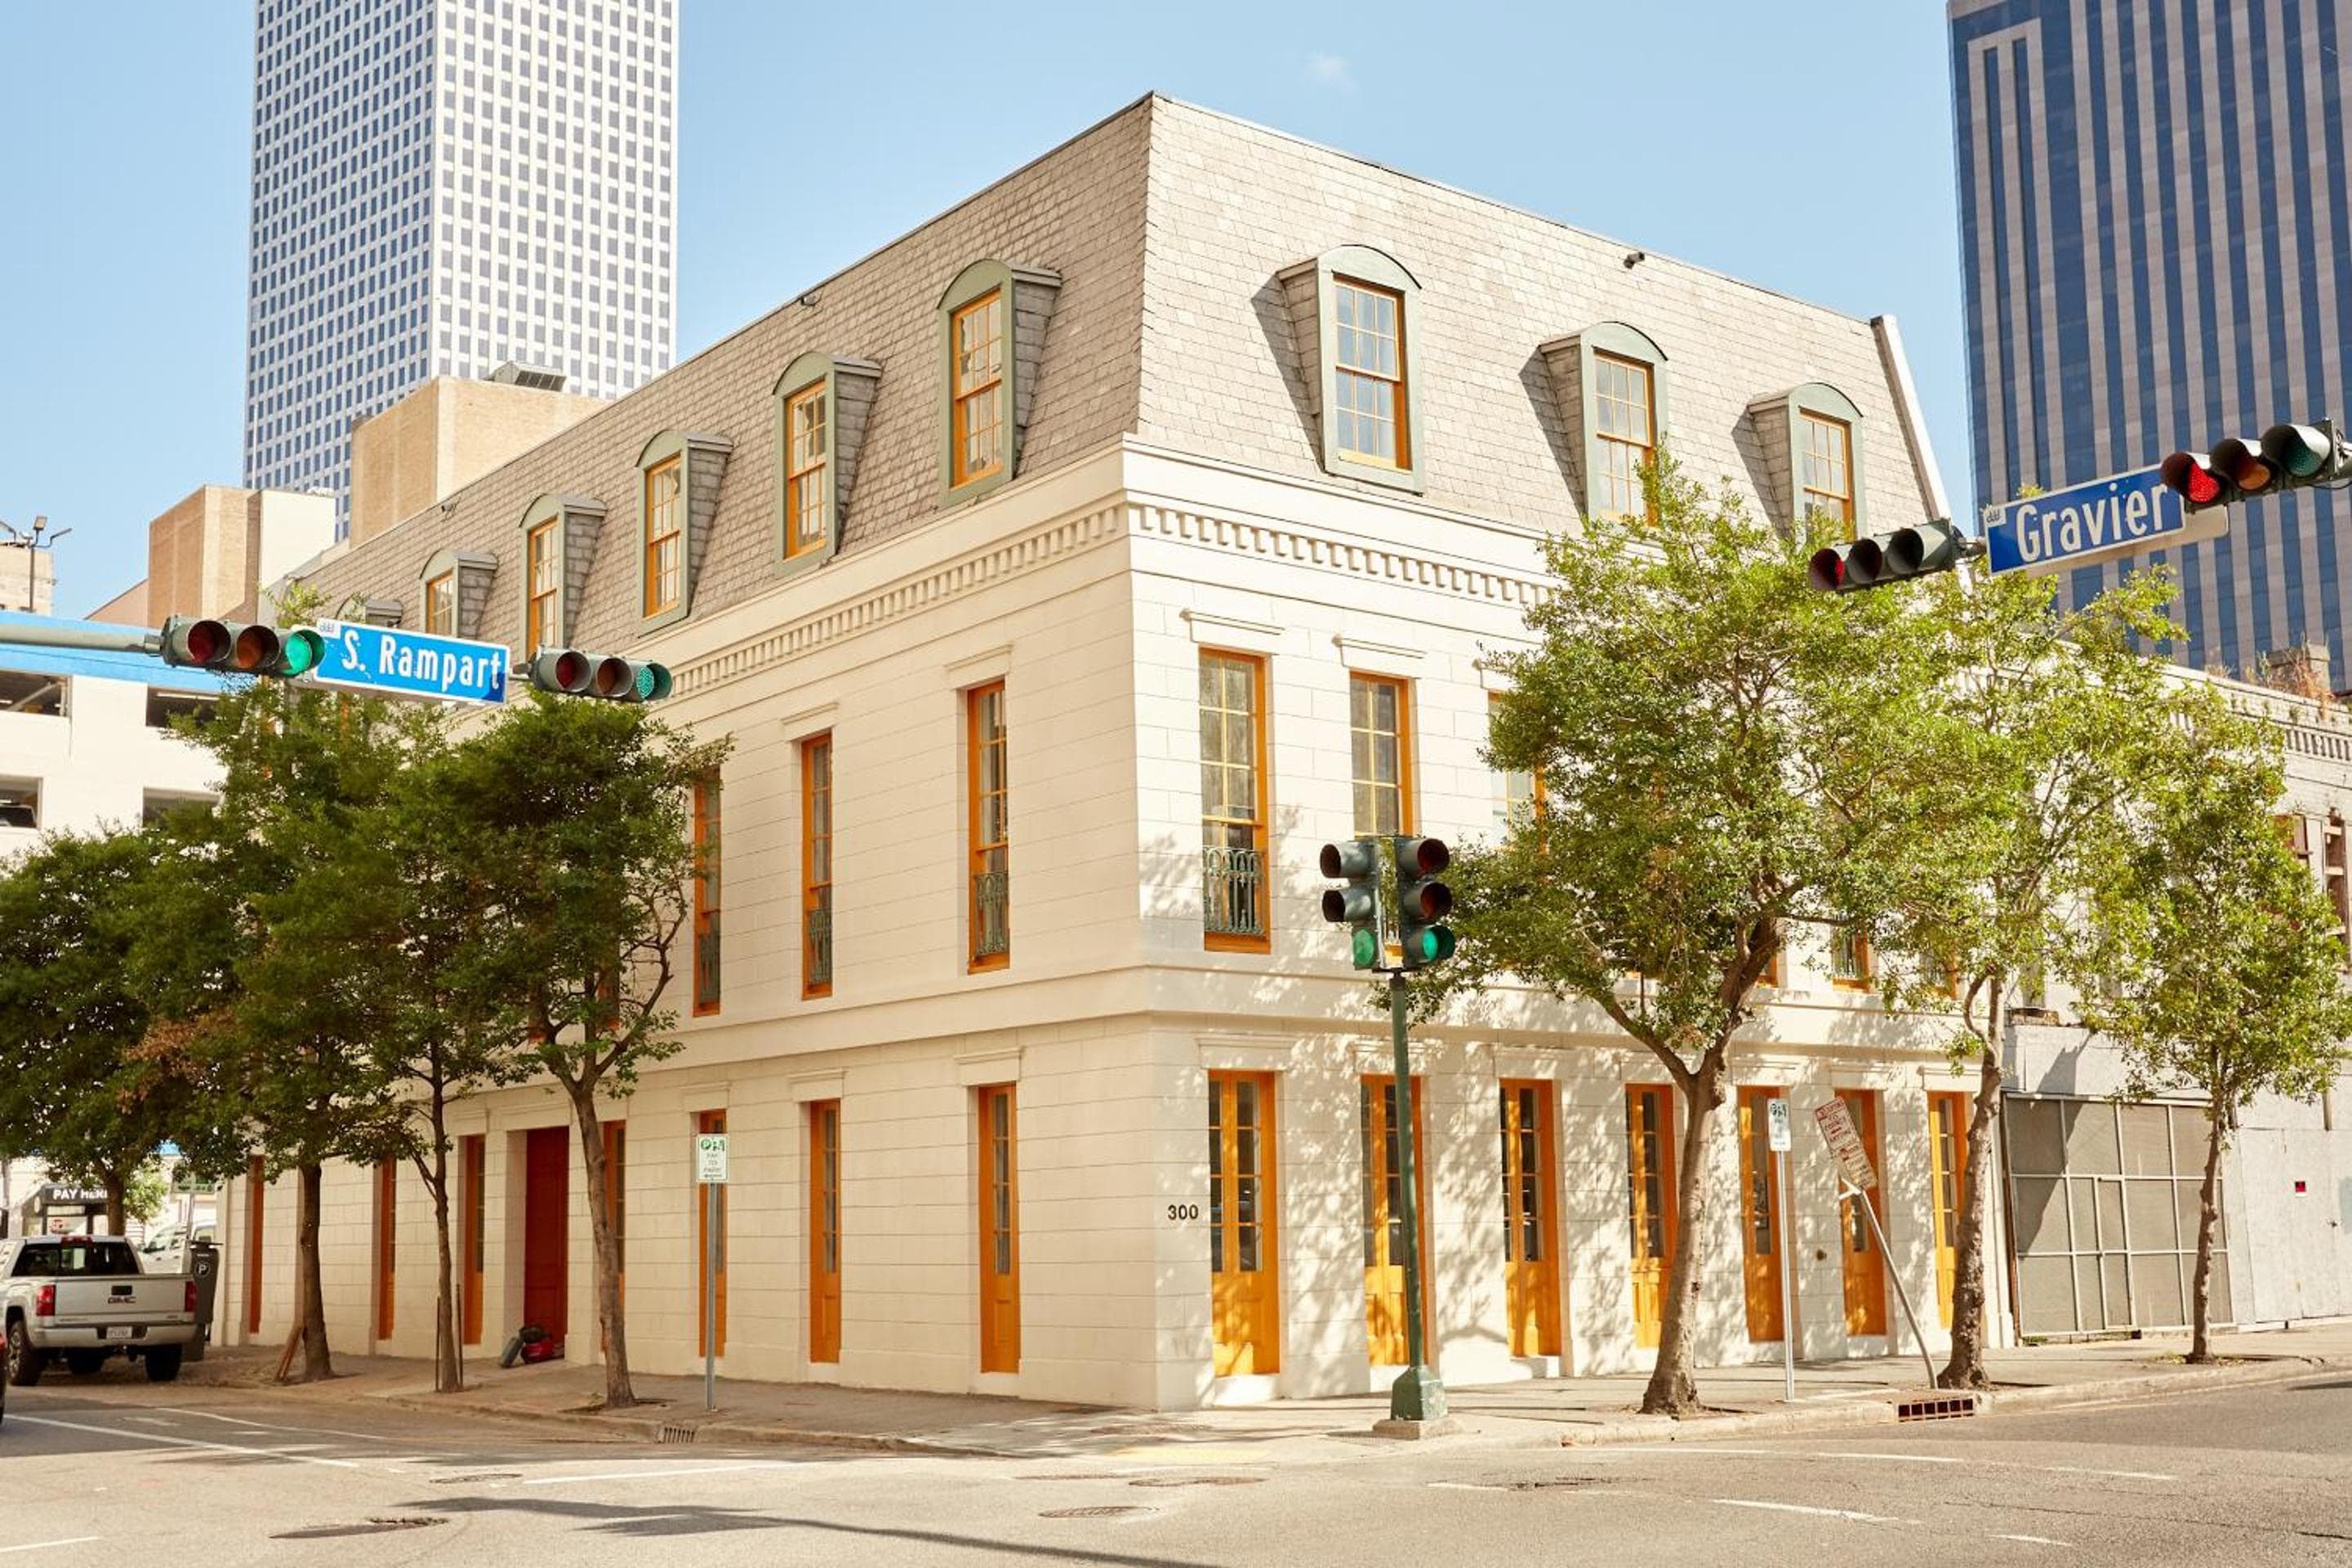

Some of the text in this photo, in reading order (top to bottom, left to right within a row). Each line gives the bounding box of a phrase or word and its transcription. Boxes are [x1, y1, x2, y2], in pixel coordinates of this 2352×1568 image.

[2016, 483, 2168, 563] Gravier
[341, 630, 501, 693] S. Rampart
[53, 1188, 108, 1200] PAY HER
[1167, 1205, 1199, 1220] 300
[198, 1264, 207, 1274] P
[108, 1296, 136, 1304] GMC
